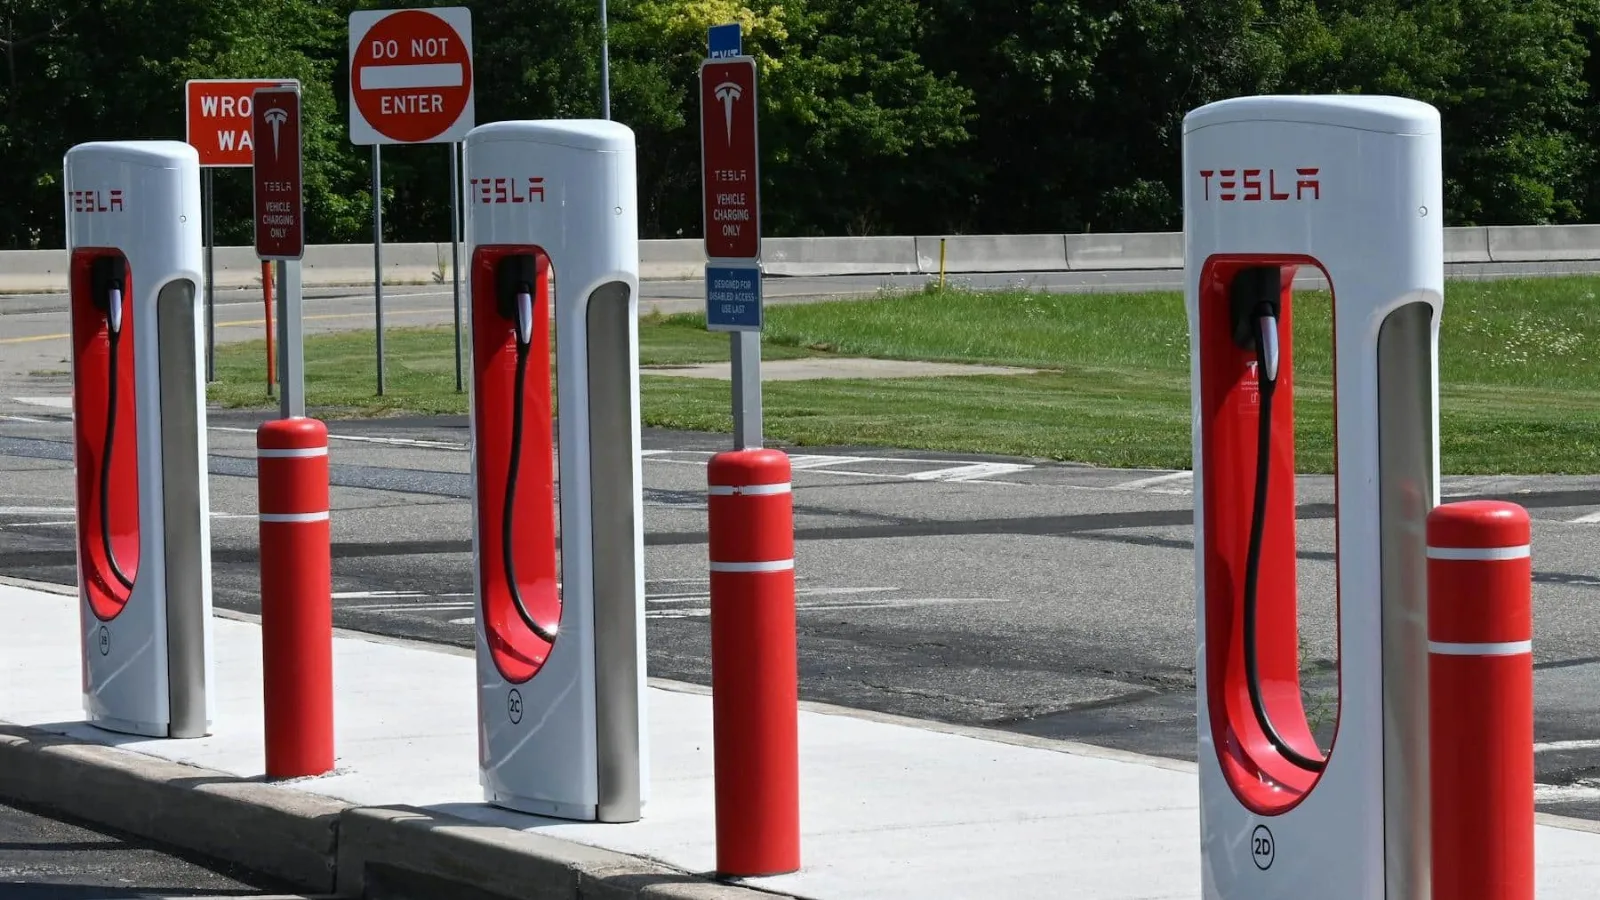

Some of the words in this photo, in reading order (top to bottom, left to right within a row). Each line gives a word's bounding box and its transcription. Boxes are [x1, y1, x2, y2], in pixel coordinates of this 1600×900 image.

[372, 40, 399, 59] DO
[411, 38, 449, 58] NOT
[200, 95, 254, 118] WRO
[381, 94, 444, 115] ENTER
[217, 130, 254, 151] WA
[714, 169, 747, 182] TESLA
[263, 181, 292, 192] TESLA
[470, 177, 544, 204] TESLA
[1199, 168, 1320, 201] TESLA
[68, 190, 123, 213] TESLA
[716, 192, 746, 206] VEHICLE
[265, 201, 291, 213] VEHICLE
[262, 214, 294, 226] CHARGING
[713, 208, 750, 222] CHARGING
[270, 227, 287, 239] ONLY
[722, 224, 741, 237] ONLY
[714, 279, 740, 290] DESIGNED
[740, 279, 752, 289] FOR
[709, 291, 733, 301] DISABLED
[721, 303, 732, 314] USE
[732, 304, 745, 314] LAST
[510, 698, 520, 713] 2C
[1254, 837, 1271, 856] 2D
